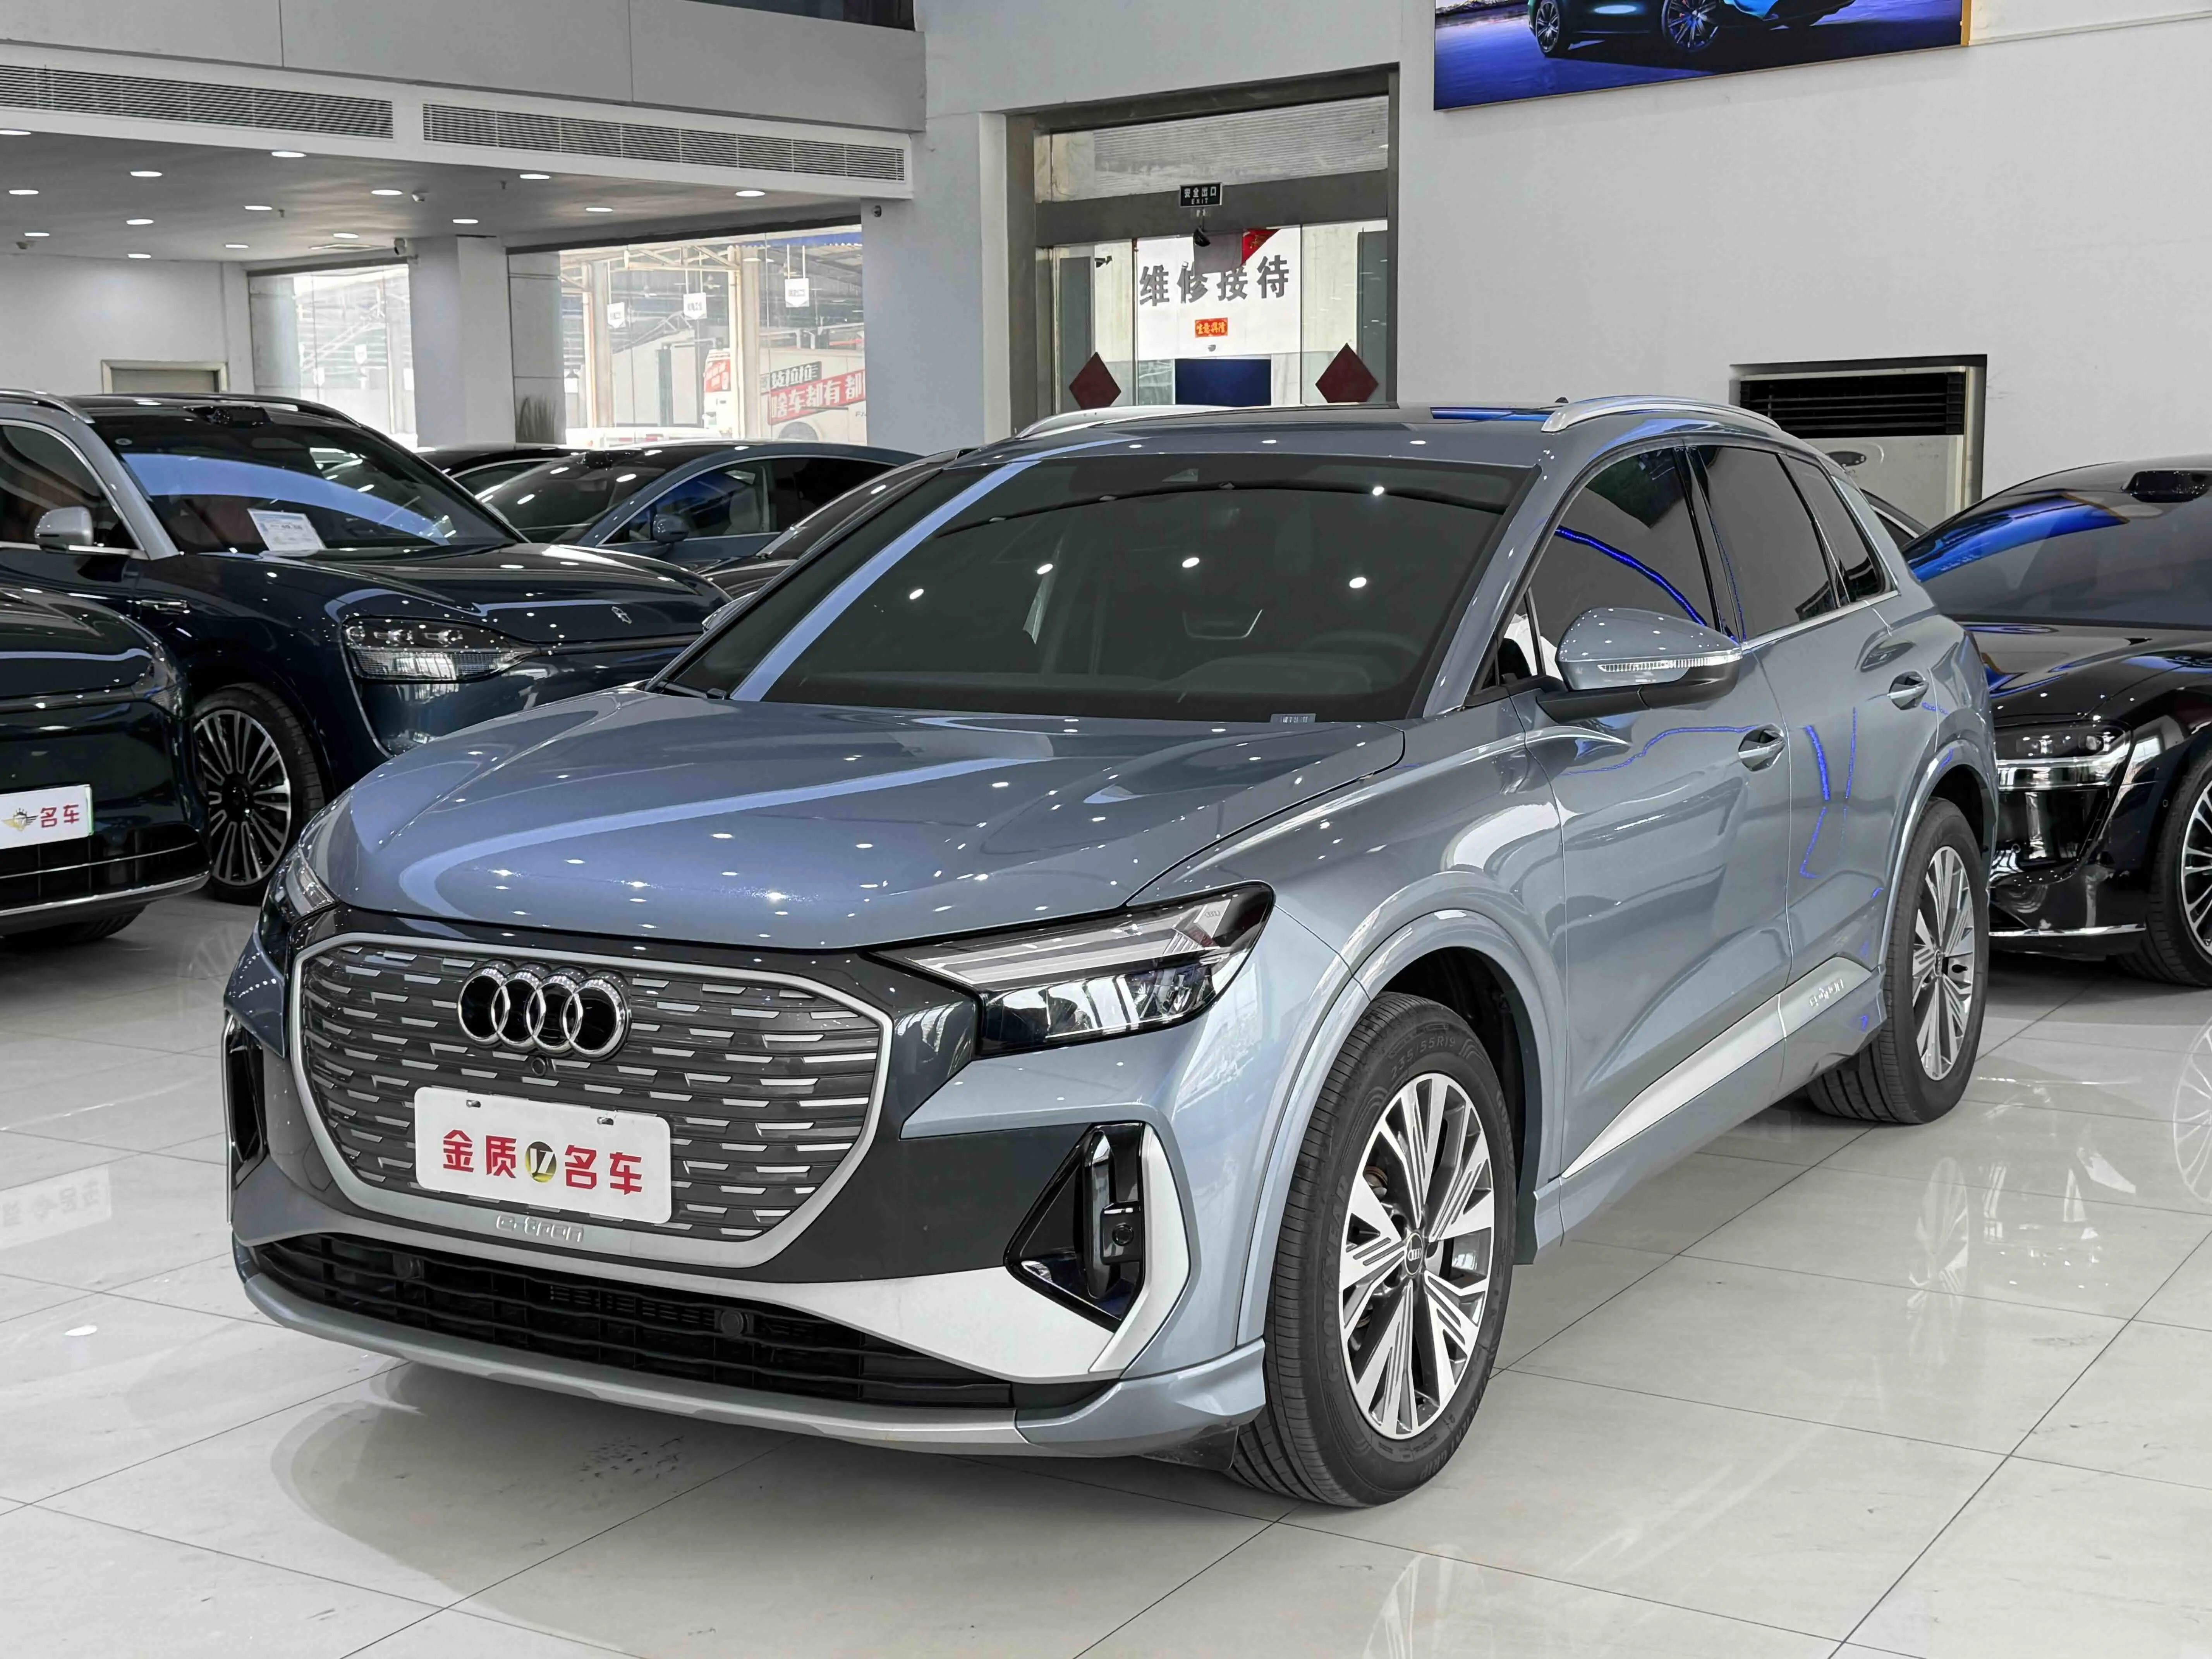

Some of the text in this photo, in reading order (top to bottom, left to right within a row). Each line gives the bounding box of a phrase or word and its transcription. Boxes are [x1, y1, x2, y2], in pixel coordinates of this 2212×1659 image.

[1184, 186, 1217, 198] 安全出口
[1139, 254, 1290, 306] 维修接待
[40, 804, 80, 828] 名车
[443, 1129, 517, 1178] 金质
[565, 1144, 642, 1195] 名车
[496, 1214, 584, 1243] e-tron
